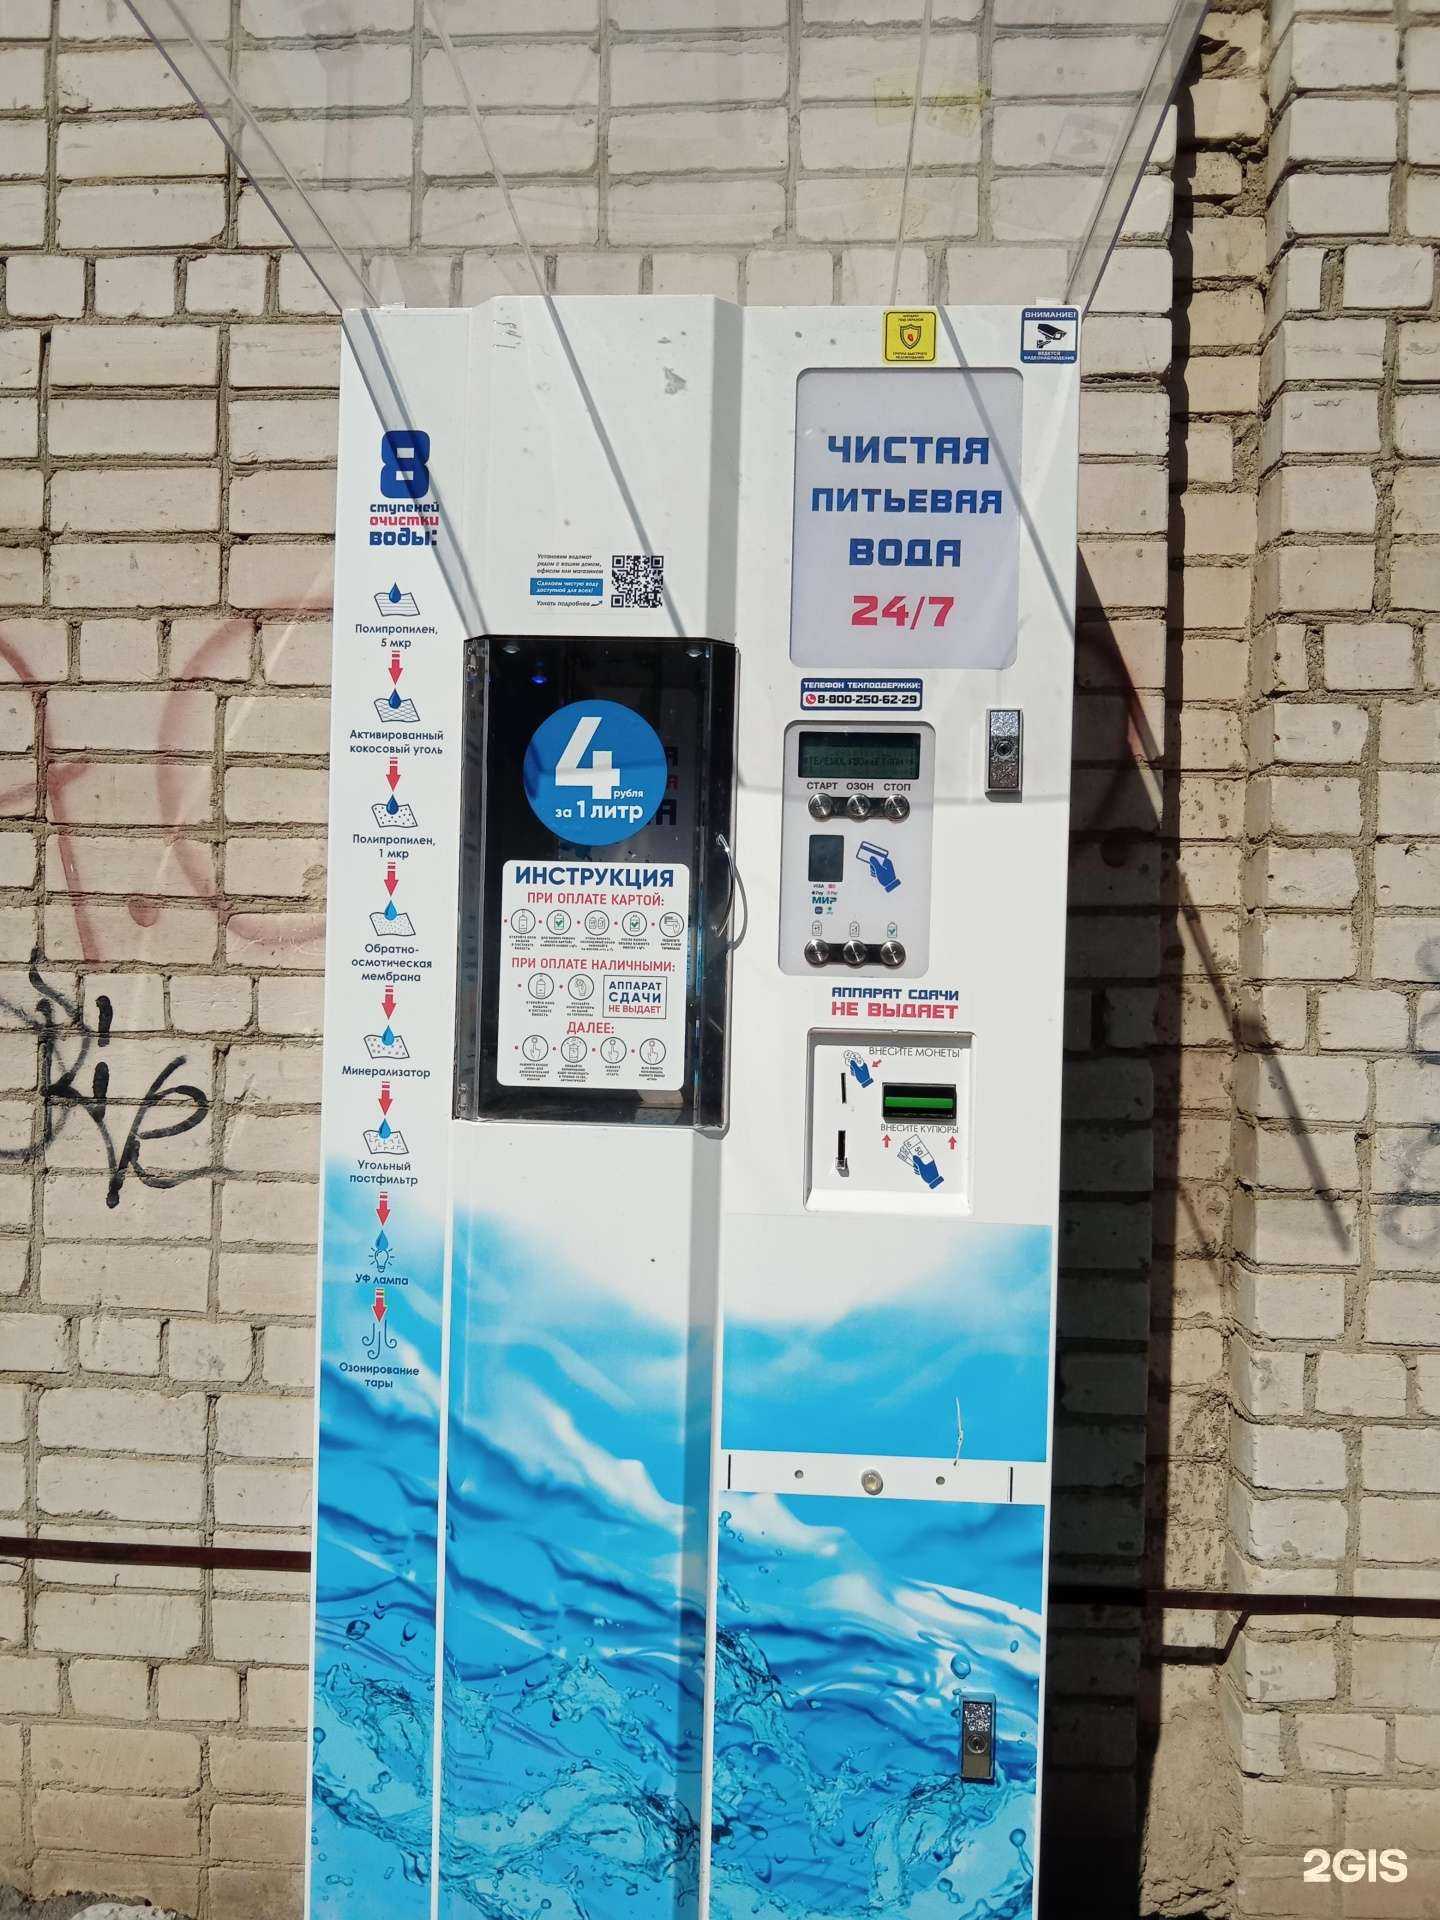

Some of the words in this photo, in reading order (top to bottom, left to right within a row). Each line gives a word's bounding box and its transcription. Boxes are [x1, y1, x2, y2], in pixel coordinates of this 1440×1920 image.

[828, 436, 990, 464] ЧИСТАЯ
[380, 430, 430, 498] 8
[811, 488, 1002, 514] ПИТЬЕВАЯ
[370, 502, 440, 514] ступеней
[370, 516, 439, 526] очистки
[369, 528, 437, 546] воды:
[848, 538, 961, 567] ВОДА
[852, 596, 954, 630] 24/7
[355, 624, 438, 635] Полипропилен,
[381, 638, 387, 647] 5
[390, 639, 411, 649] мкр
[818, 695, 917, 704] 8-800-250-62-29
[350, 730, 444, 742] Активированный
[350, 743, 410, 754] кокосовый
[414, 746, 443, 756] уголь
[555, 717, 620, 800] 4
[614, 789, 644, 799] рубля
[555, 808, 572, 818] за
[576, 800, 585, 818] 1
[590, 805, 644, 823] литр
[353, 834, 436, 846] Полипропилен,
[379, 850, 383, 858] 1
[386, 850, 409, 861] мкр
[515, 866, 674, 889] ИНСТРУКЦИЯ
[528, 892, 552, 903] ПРИ
[558, 893, 606, 905] ОПЛАТЕ
[611, 892, 664, 906] КАРТОЙ:
[365, 944, 419, 955] Обратно-
[352, 959, 432, 969] осмотическая
[512, 957, 536, 968] ПРИ
[540, 958, 587, 969] ОПЛАТЕ
[592, 960, 675, 972] НАЛИЧНЫМИ:
[361, 972, 421, 982] мембрана
[609, 981, 662, 991] АППАРАТ
[609, 992, 661, 1003] СДАЧИ
[832, 986, 902, 998] АППАРАТ
[908, 989, 959, 1000] СДАЧИ
[608, 1005, 620, 1013] НЕ
[622, 1005, 661, 1014] ВЫДАЕТ
[832, 1002, 859, 1017] НЕ
[868, 1003, 958, 1019] ВЫДАЕТ
[567, 1022, 614, 1034] ДАЛЕЕ:
[869, 1047, 913, 1057] ВНЕСИТЕ
[914, 1048, 960, 1058] МОНЕТЫ
[342, 1066, 430, 1079] Минерализатор
[880, 1124, 918, 1133] ВНЕСИТЕ
[920, 1125, 959, 1134] КУПЮРЫ
[357, 1160, 411, 1172] Угольный
[350, 1174, 418, 1187] постфильтр
[355, 1273, 370, 1283] УФ
[373, 1276, 409, 1286] лампа
[339, 1362, 419, 1376] Озонирование
[365, 1380, 393, 1389] тары
